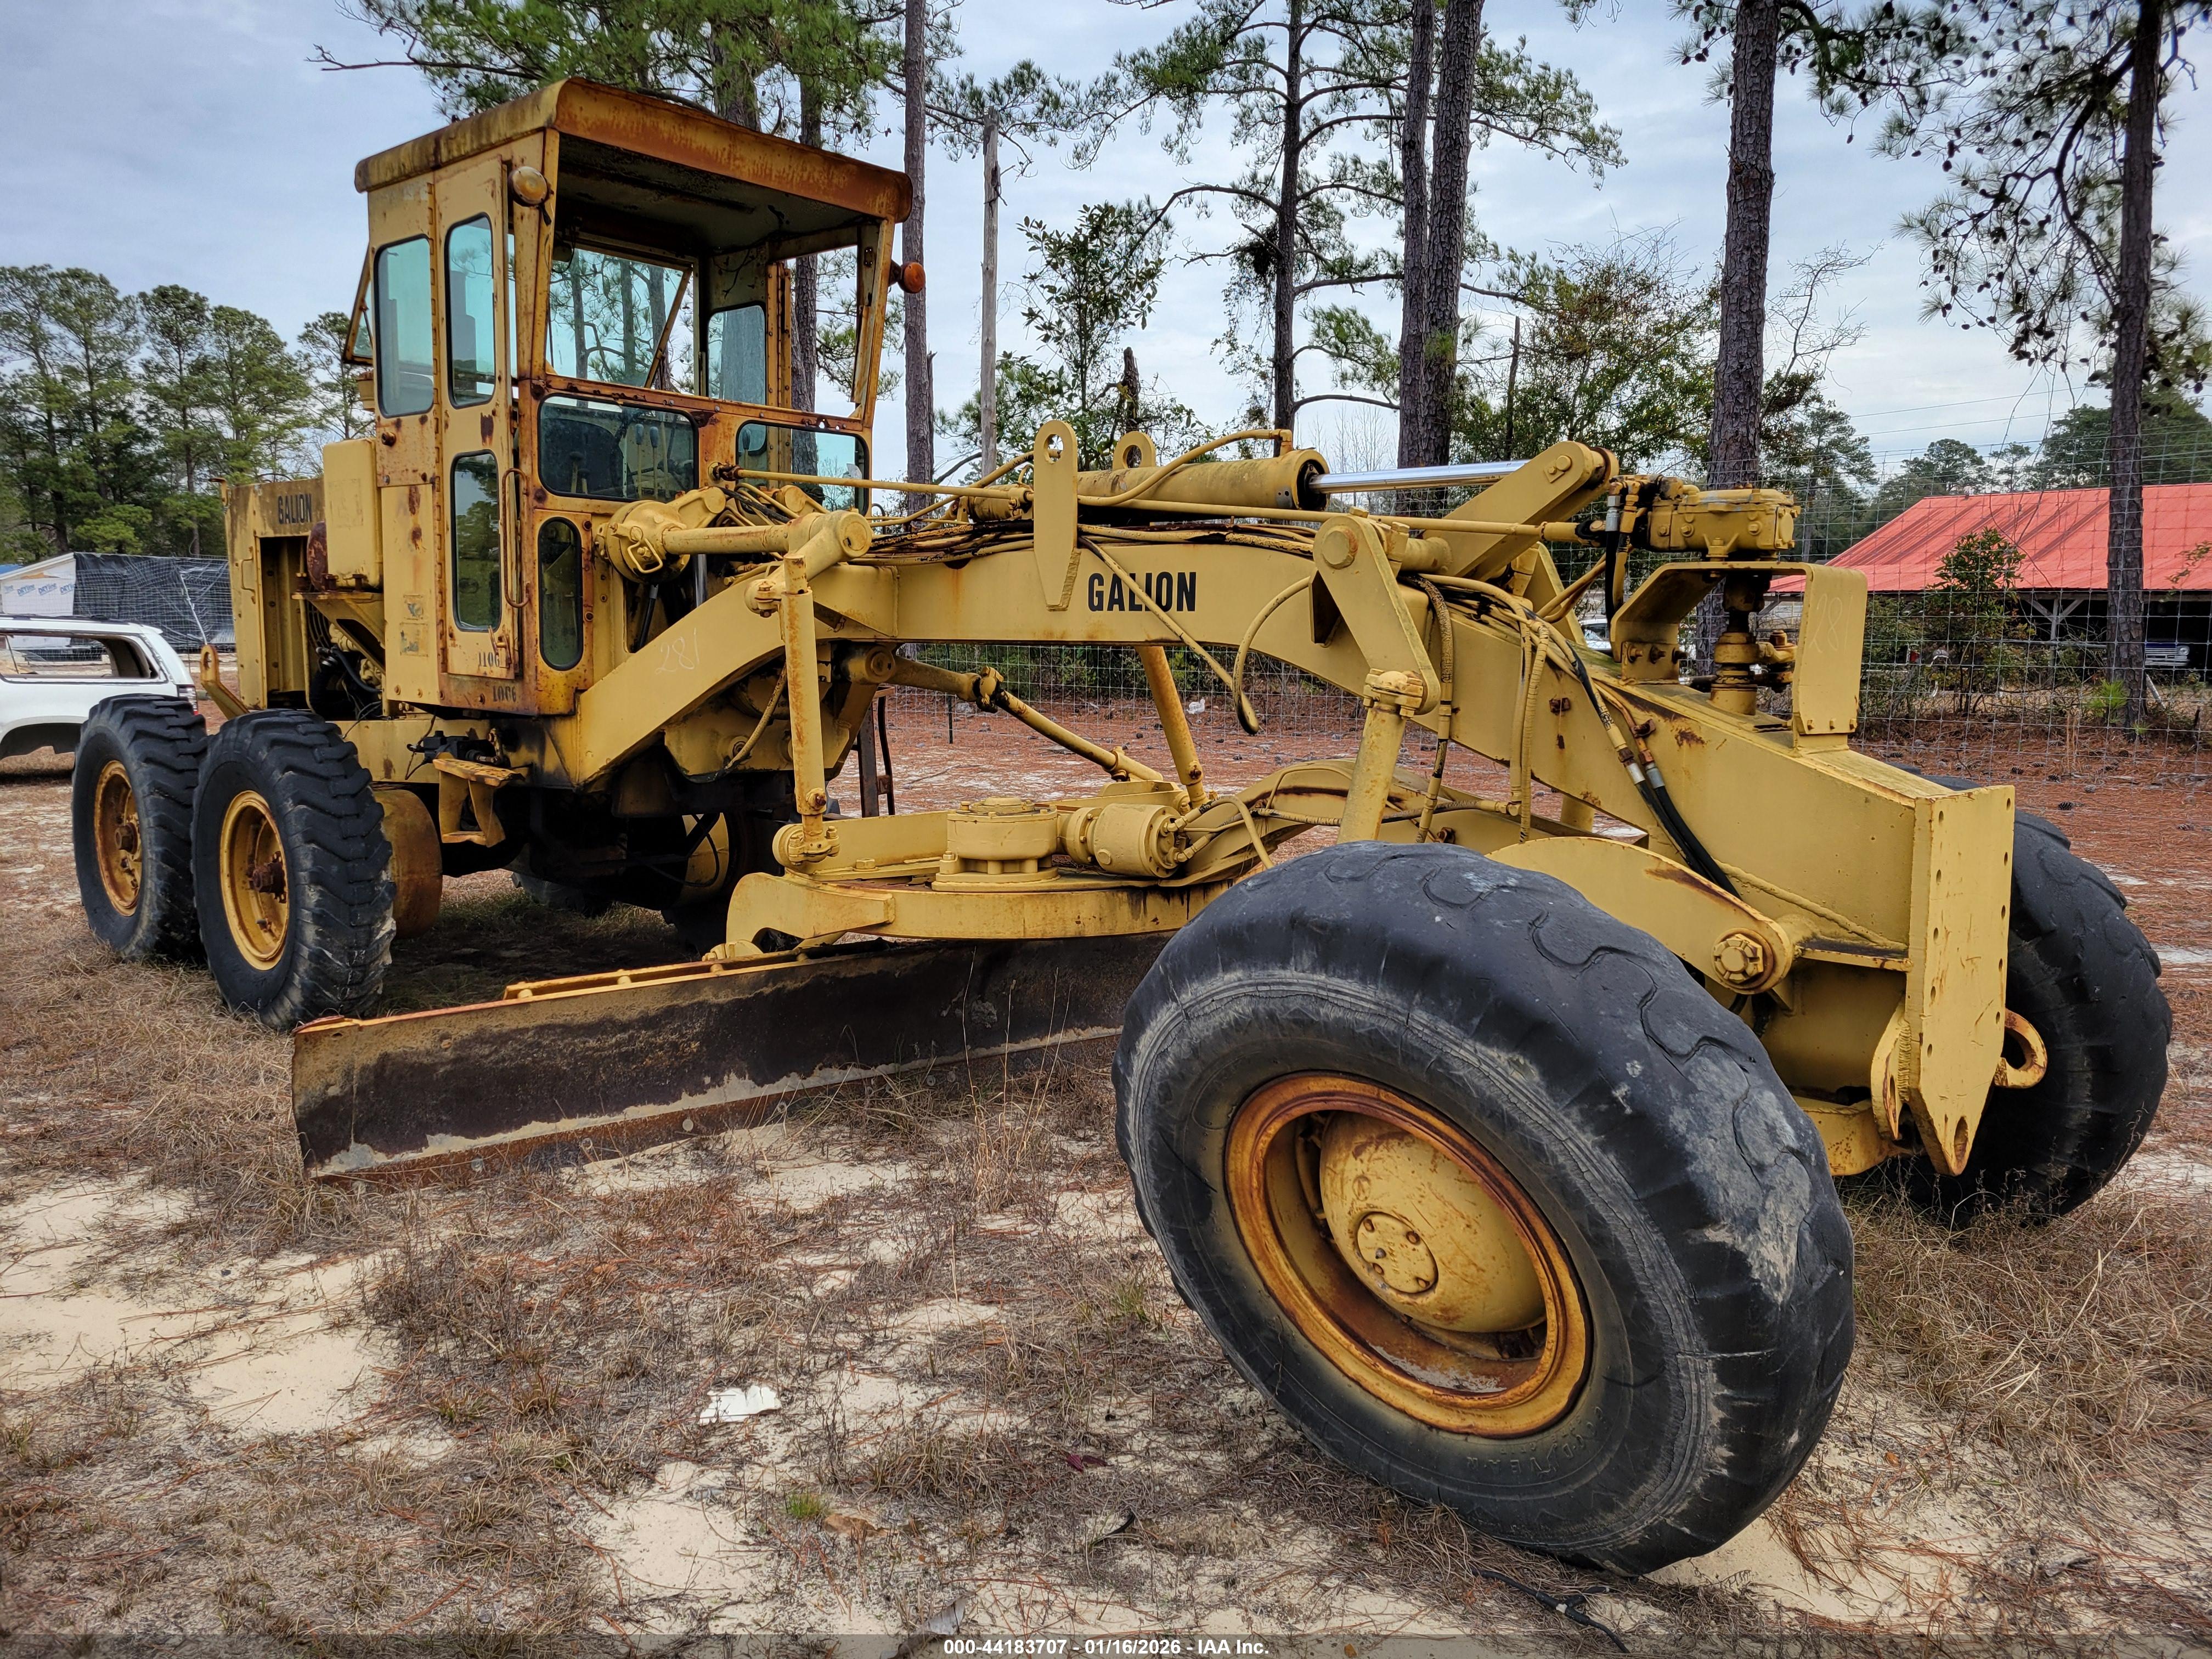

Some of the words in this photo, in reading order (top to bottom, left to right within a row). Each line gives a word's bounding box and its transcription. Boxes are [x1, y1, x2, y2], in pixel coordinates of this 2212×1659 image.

[278, 493, 312, 524] GALION
[1087, 571, 1197, 612] GALION
[1809, 593, 1854, 655] 281
[655, 627, 699, 675] 281
